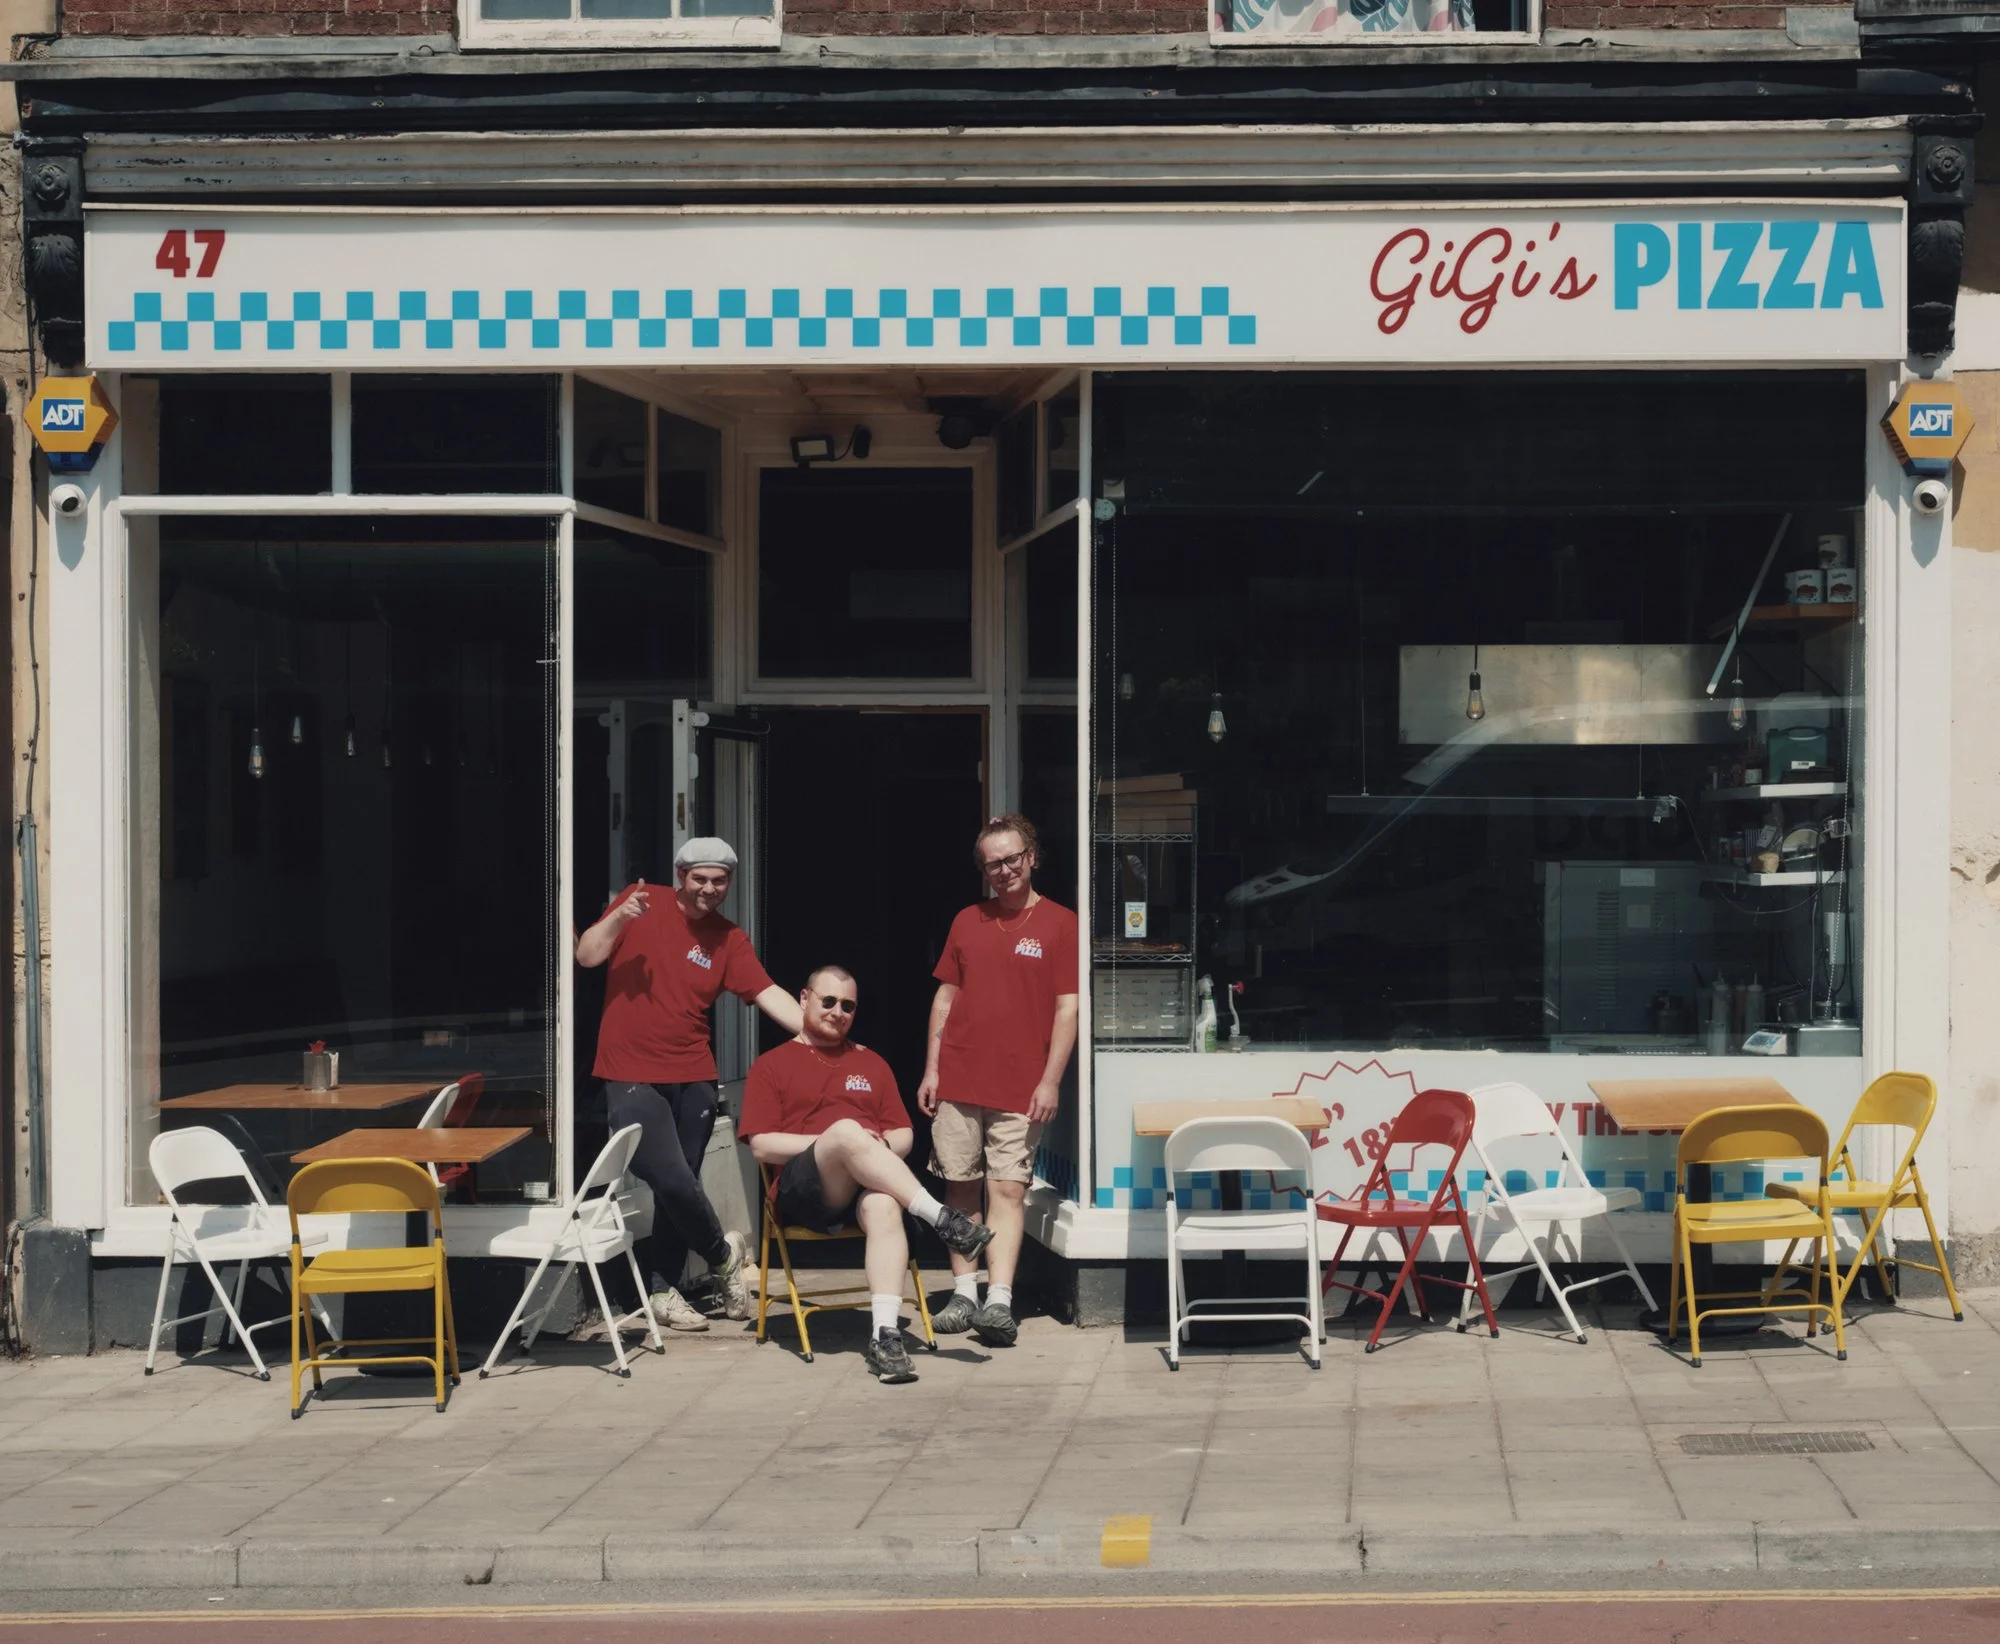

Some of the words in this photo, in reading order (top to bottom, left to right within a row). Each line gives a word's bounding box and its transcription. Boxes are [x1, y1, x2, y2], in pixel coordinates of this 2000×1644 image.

[156, 230, 226, 278] 47
[1370, 221, 1598, 334] GiGi's
[1614, 220, 1885, 310] PIZZA
[42, 404, 84, 426] ADT
[1909, 409, 1953, 431] ADT
[687, 950, 712, 970] PIZZA
[1014, 944, 1043, 959] PIZZA
[845, 1080, 872, 1092] PIZZA
